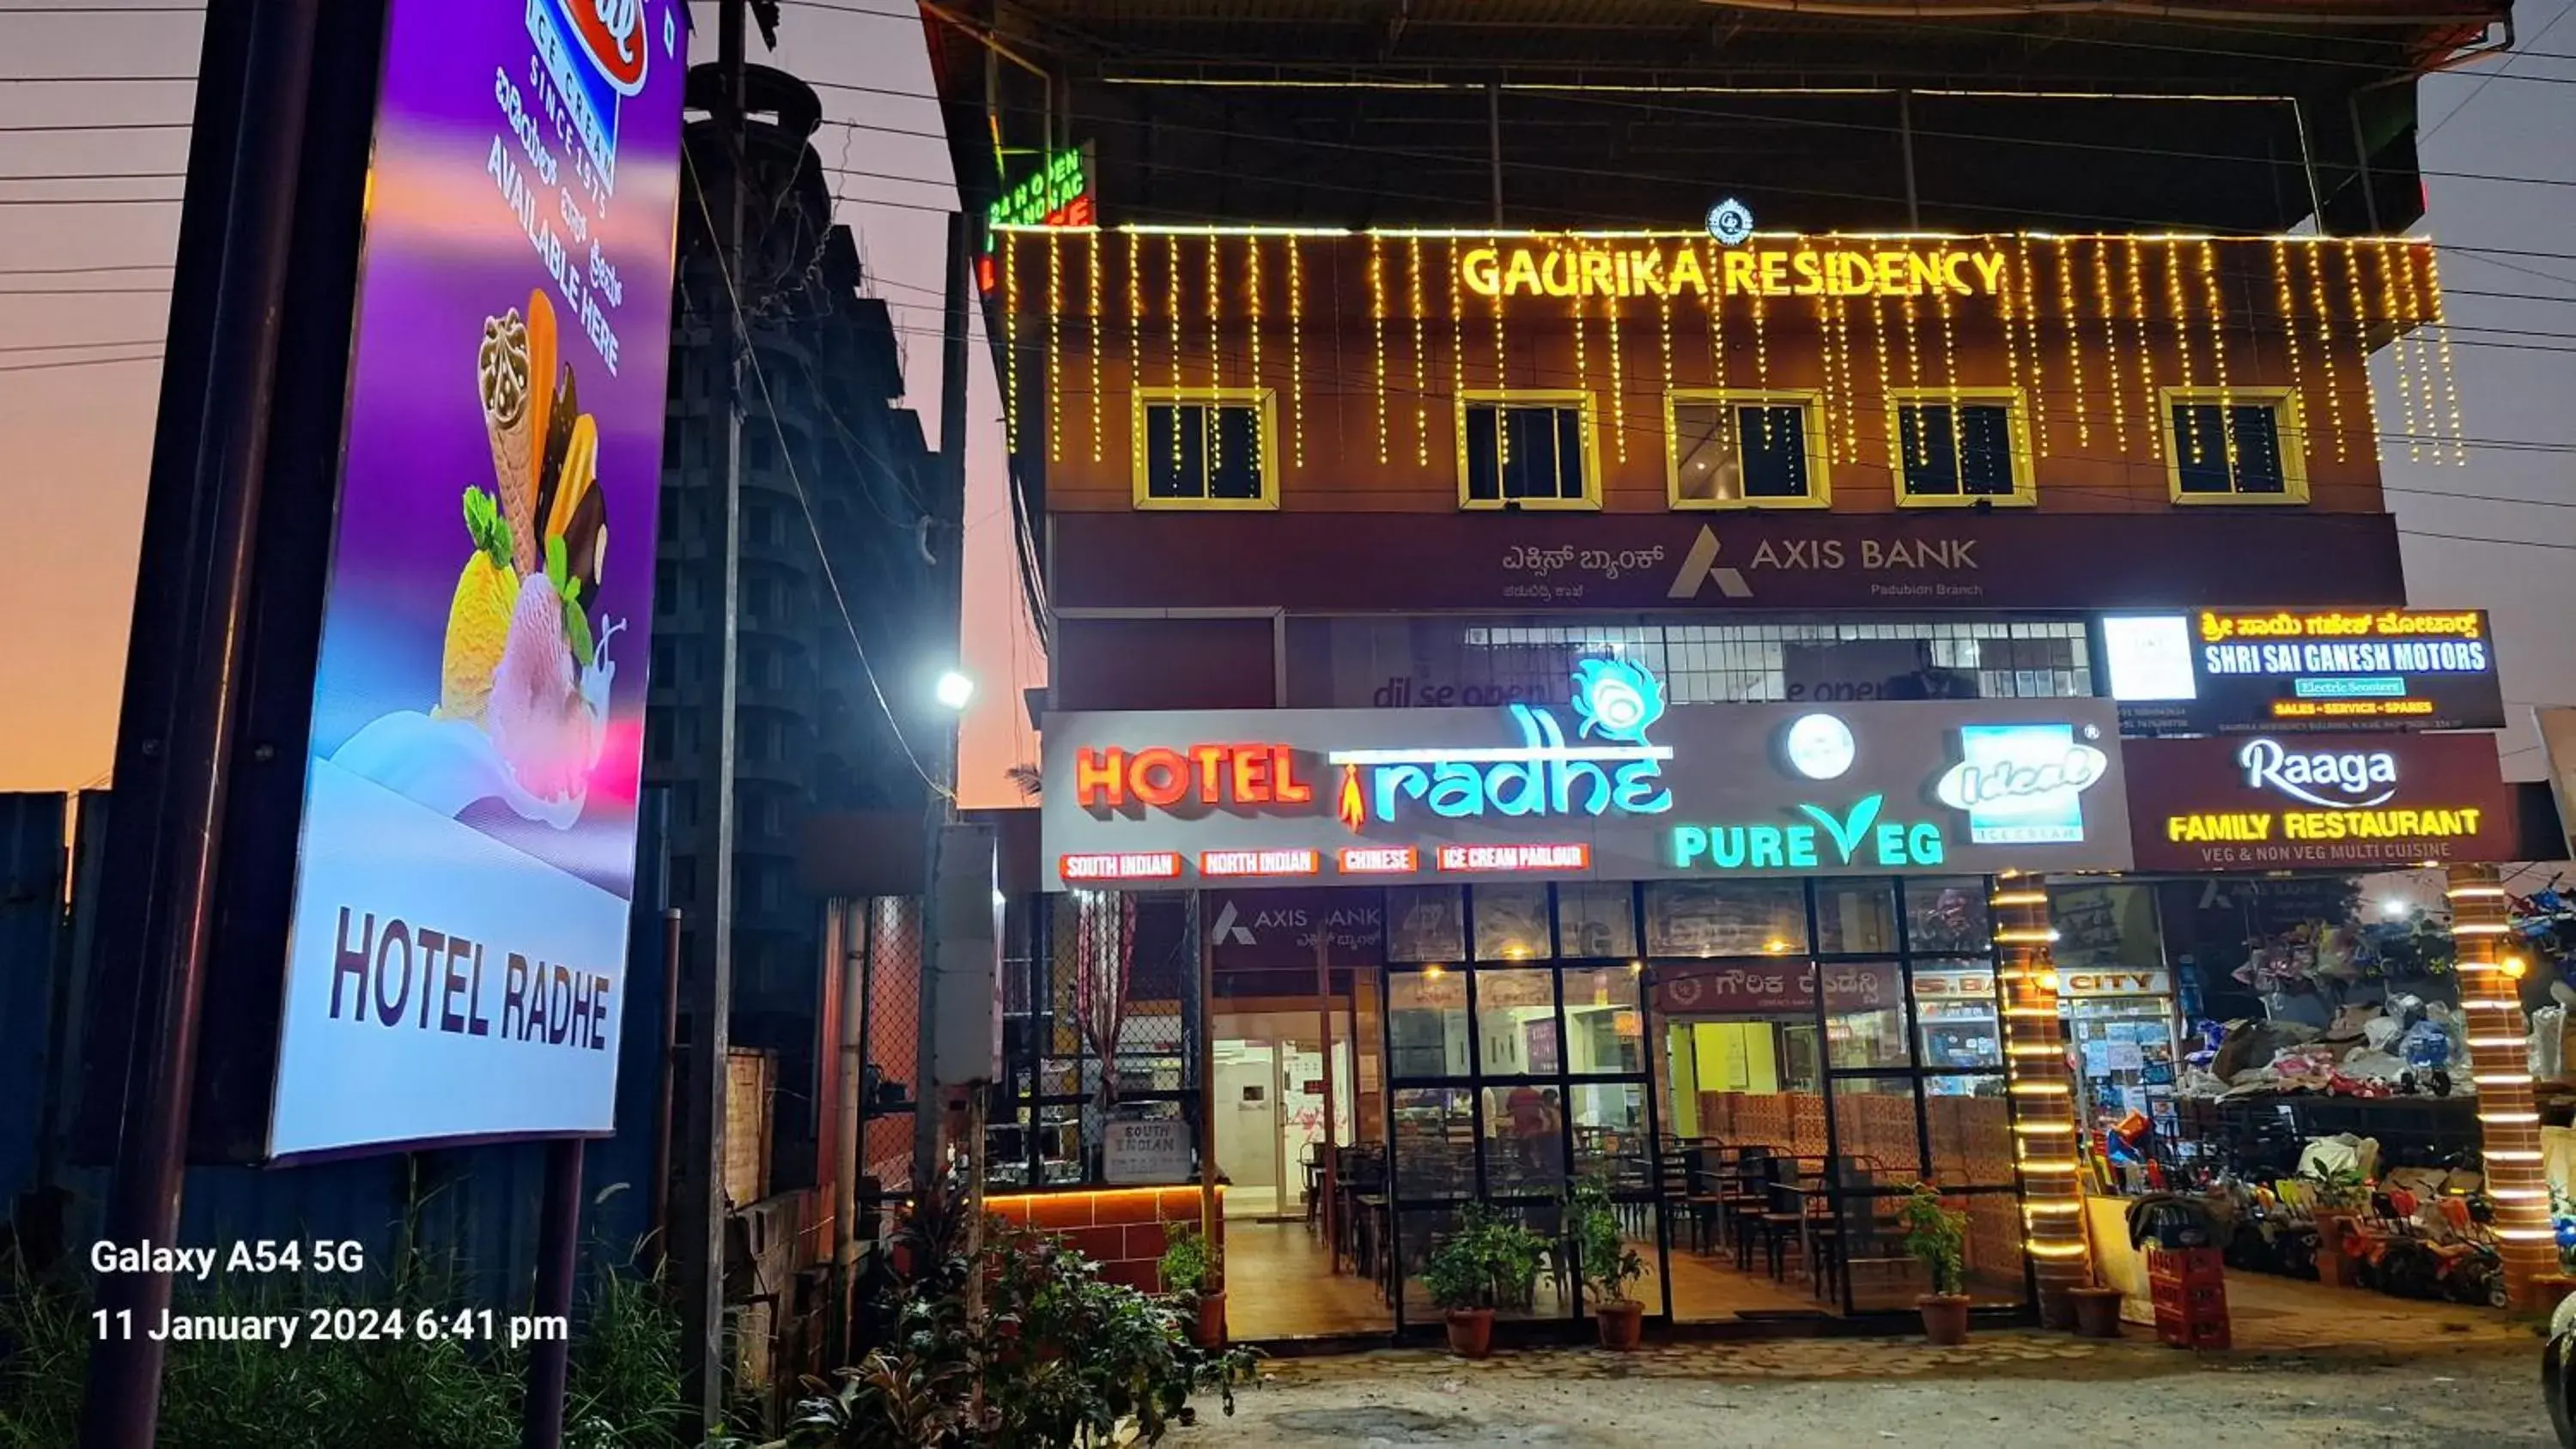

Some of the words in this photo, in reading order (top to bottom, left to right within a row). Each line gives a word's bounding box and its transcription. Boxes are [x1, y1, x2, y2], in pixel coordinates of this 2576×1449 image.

[530, 55, 574, 155] SINCE
[577, 147, 606, 220] 1975
[488, 133, 580, 314] AVAILABLE
[580, 286, 619, 379] HERE
[1462, 249, 1709, 297] GAURIKA
[1725, 250, 2004, 297] RESIDENCY
[1750, 539, 1845, 569] AXIS
[1860, 539, 1979, 569] BANK
[2205, 645, 2261, 674] SHRI
[2263, 645, 2303, 673] SAI
[2304, 643, 2391, 672] GANESH
[2393, 641, 2486, 671] MOTORS
[2301, 680, 2344, 693] Electric
[2274, 702, 2316, 715] SALES
[2324, 701, 2377, 714] SERVICE
[2385, 700, 2433, 714] SPARES
[1076, 743, 1312, 807] HOTEL
[1961, 747, 2090, 806] Ideal
[2240, 739, 2397, 807] Raaga
[1674, 825, 1818, 867] PURE
[1800, 794, 1944, 864] VEG
[2168, 812, 2272, 841] FAMILY
[2285, 808, 2480, 840] RESTAURANT
[1068, 856, 1117, 876] SOUTH
[1121, 854, 1173, 876] INDIAN
[1207, 852, 1257, 873] NORTH
[1261, 851, 1312, 872] INDIAN
[1345, 850, 1409, 870] CHINESE
[1443, 848, 1467, 868] ICE
[1472, 847, 1516, 868] CREAM
[1518, 846, 1583, 867] PARLOUR
[2202, 846, 2234, 863] VEG
[2240, 846, 2253, 861] &
[2256, 846, 2291, 861] NON
[2293, 845, 2326, 860] VEG
[2330, 843, 2380, 859] MULTI
[2385, 841, 2451, 858] CUISINE
[1254, 910, 1309, 928] AXIS
[1326, 908, 1381, 926] ANK
[330, 906, 489, 1037] HOTEL
[501, 952, 609, 1051] RADHE
[2069, 973, 2155, 991] CITY
[1125, 1125, 1170, 1137] SOUTH
